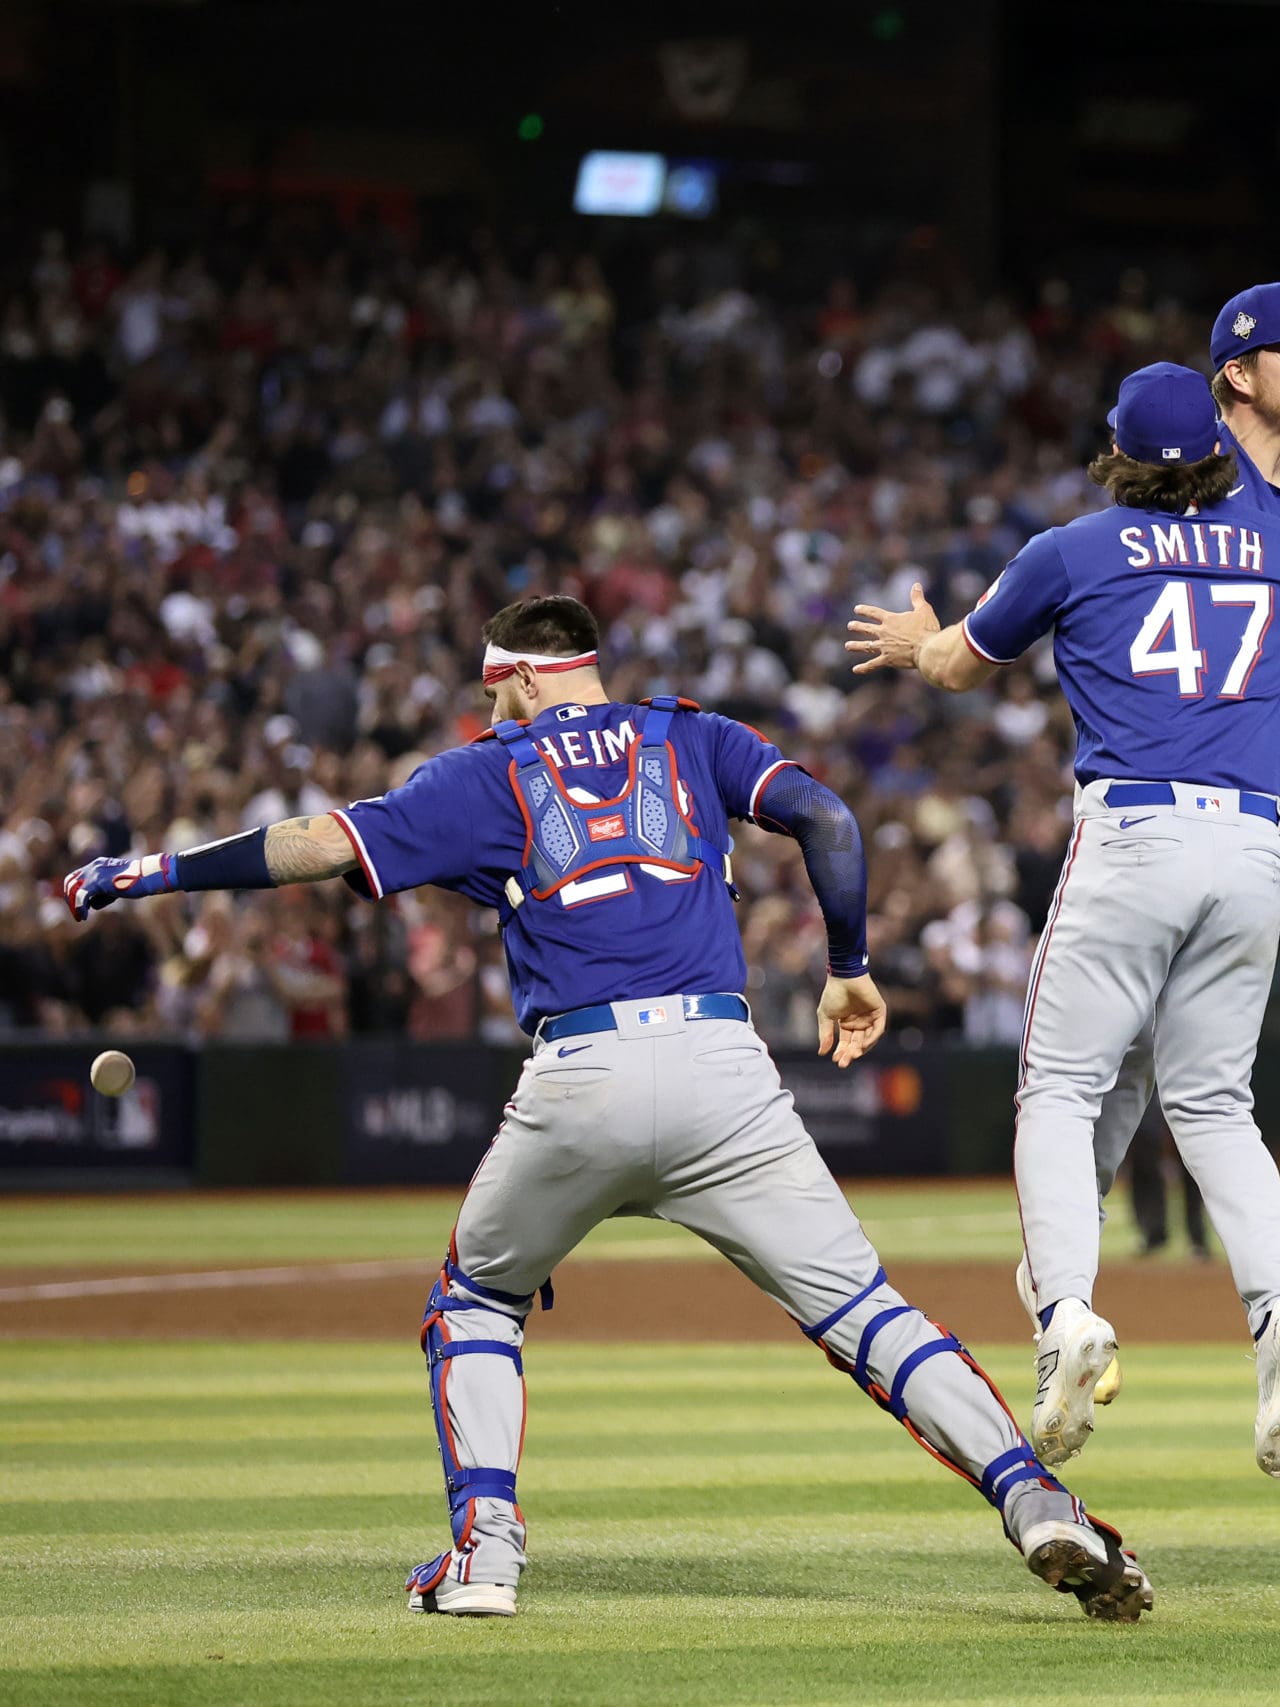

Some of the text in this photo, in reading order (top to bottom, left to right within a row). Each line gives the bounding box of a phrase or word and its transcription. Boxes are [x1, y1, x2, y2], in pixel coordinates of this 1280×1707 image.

[1119, 523, 1264, 574] SMITH
[1129, 580, 1274, 700] 47
[531, 719, 638, 770] HEIM
